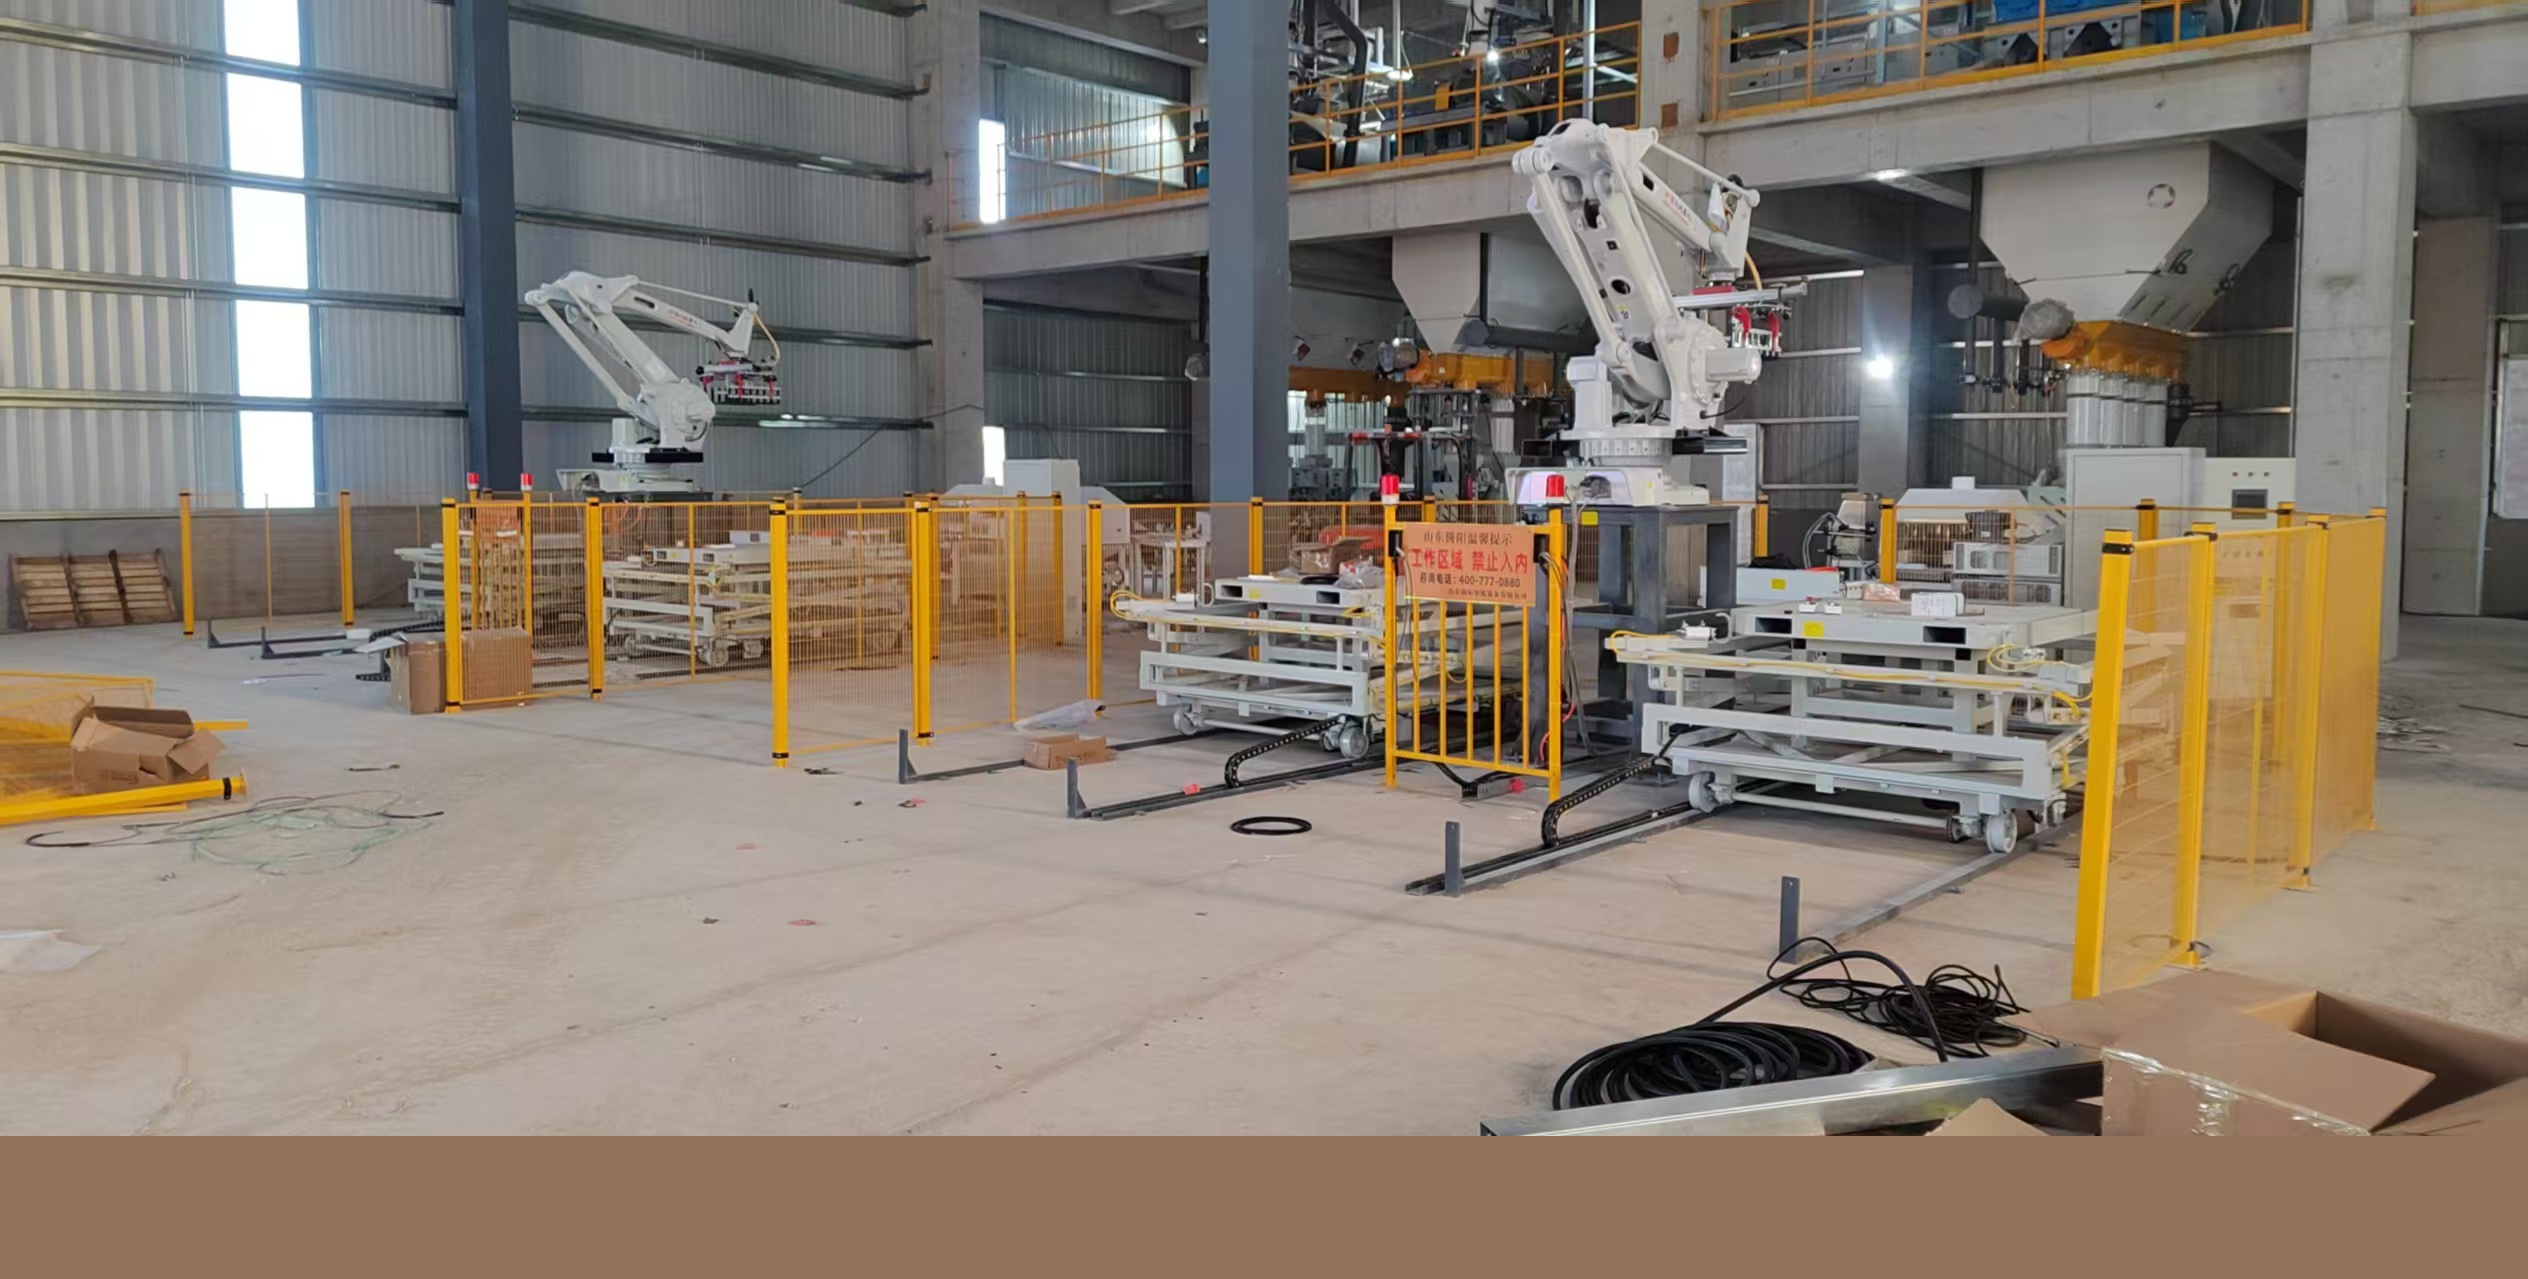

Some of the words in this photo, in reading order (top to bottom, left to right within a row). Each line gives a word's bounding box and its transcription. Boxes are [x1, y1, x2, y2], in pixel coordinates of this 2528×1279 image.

[1411, 548, 1463, 570] 工作区域
[1472, 551, 1528, 574] 禁止入内
